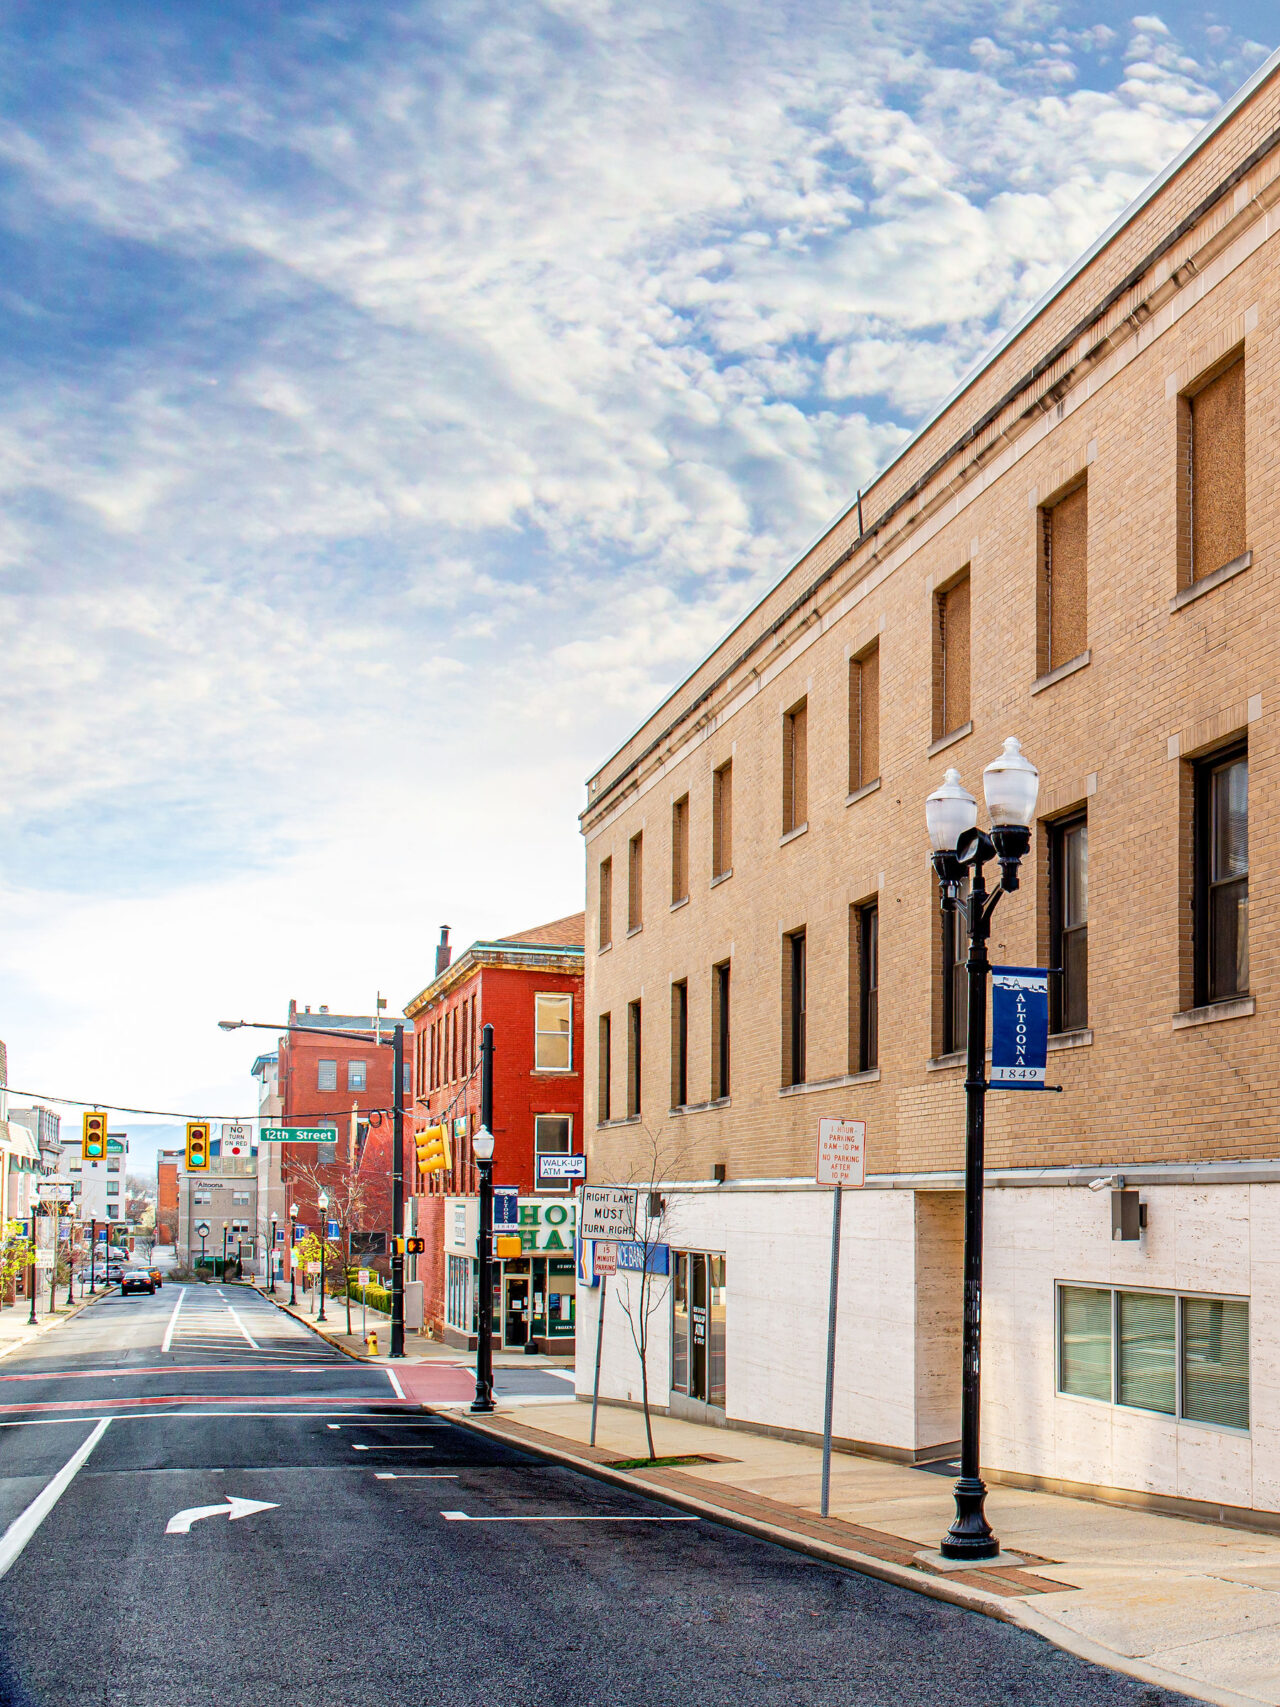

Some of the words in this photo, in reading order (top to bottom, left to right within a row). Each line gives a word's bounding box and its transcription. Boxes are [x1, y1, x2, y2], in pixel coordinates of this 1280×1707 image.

[1016, 993, 1026, 1066] ALTOONA
[1000, 1069, 1037, 1079] 1849
[265, 1130, 288, 1139] 12th
[296, 1130, 332, 1139] Street
[829, 1134, 855, 1142] PARKING
[834, 1155, 859, 1163] PARKING
[587, 1193, 610, 1202] RIGHT
[614, 1194, 634, 1204] LANE
[594, 1208, 623, 1220] MUST
[584, 1223, 605, 1233] TURN
[608, 1226, 633, 1235] RIGHT
[603, 1246, 610, 1254] 15
